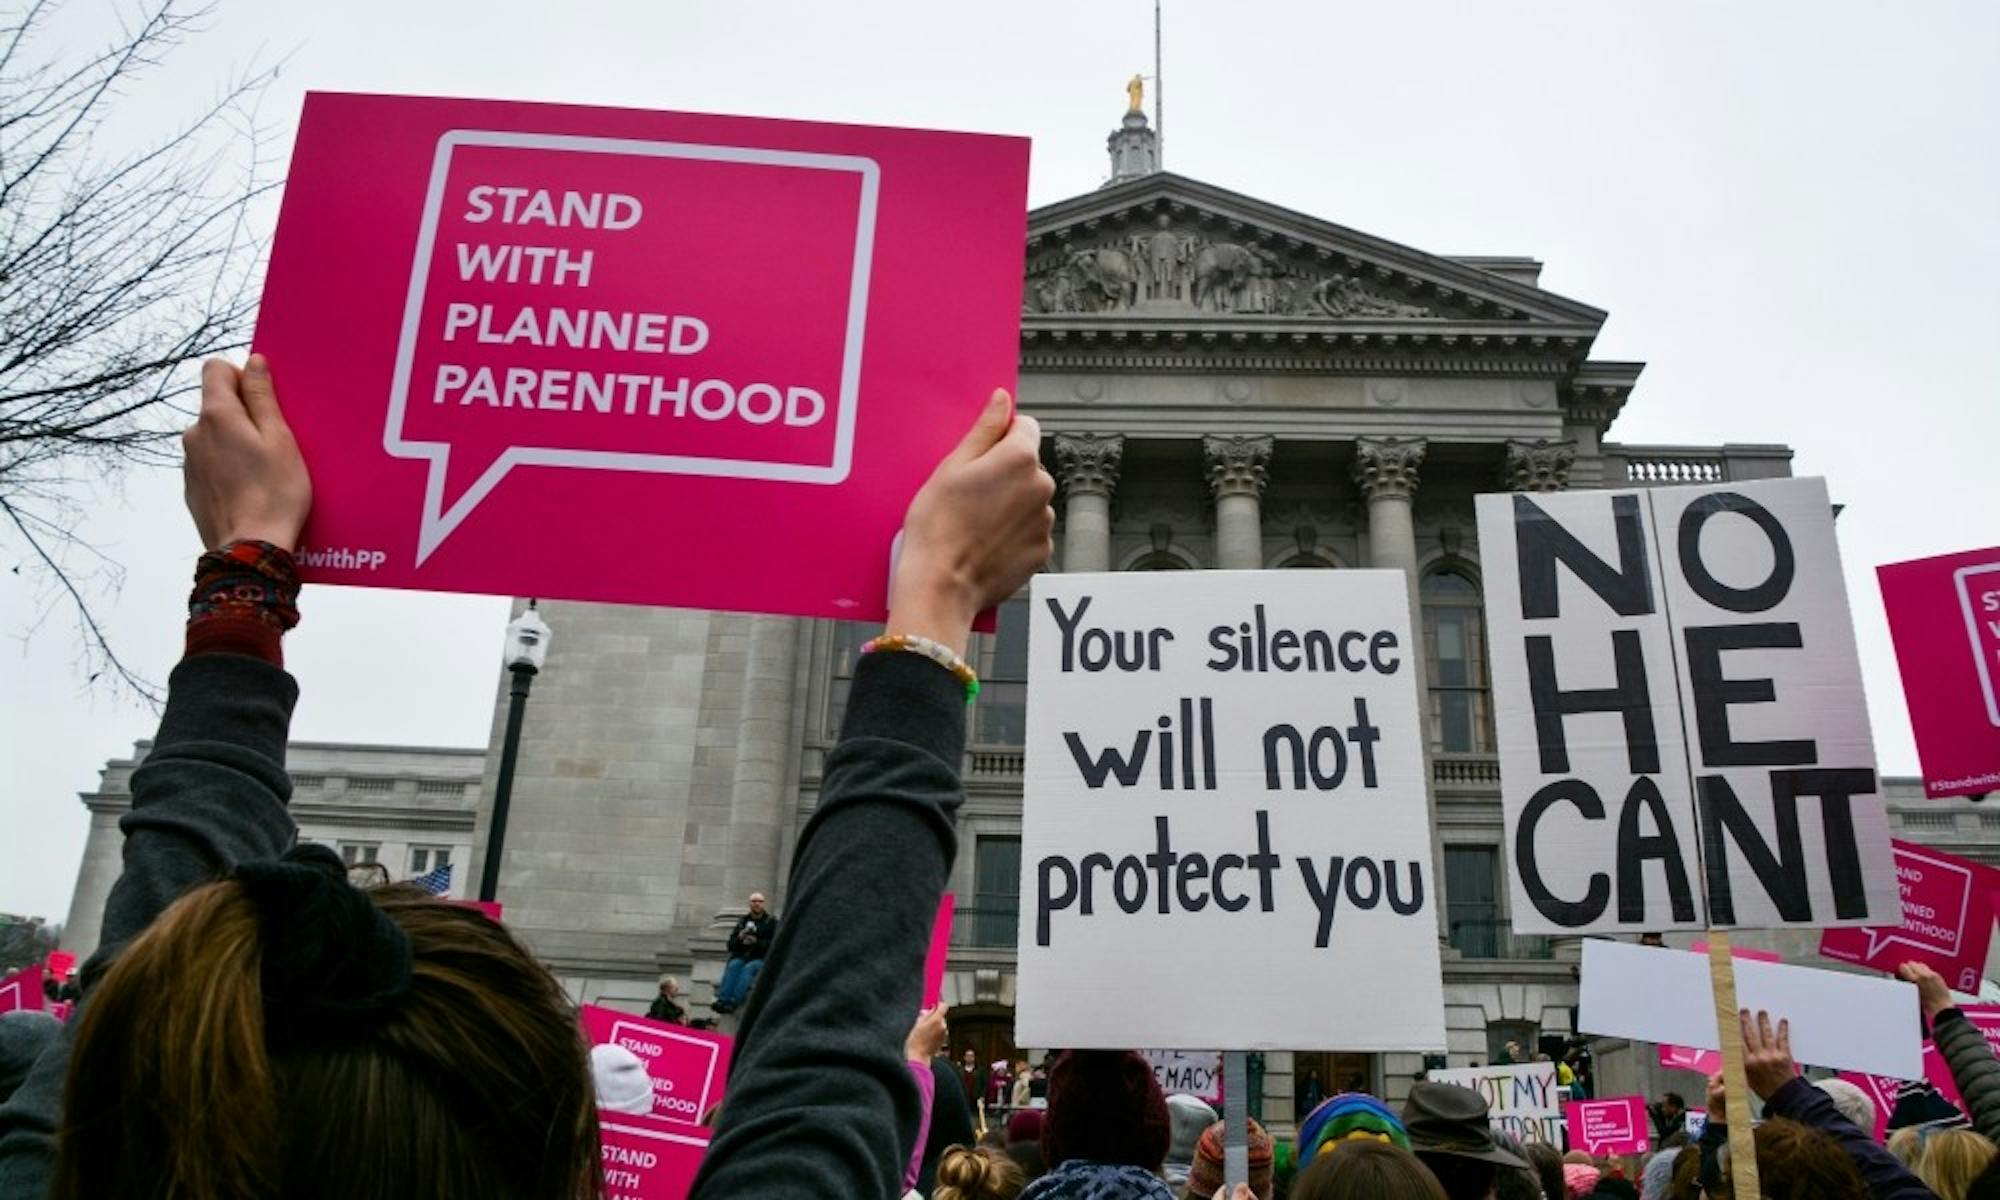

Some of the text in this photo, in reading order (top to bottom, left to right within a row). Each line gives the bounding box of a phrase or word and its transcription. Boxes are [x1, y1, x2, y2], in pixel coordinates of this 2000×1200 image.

[463, 185, 643, 231] STAND
[456, 242, 594, 288] WITH
[443, 302, 710, 356] PLANNED
[432, 364, 826, 428] PARENTHOOD
[1512, 491, 1796, 620] NO
[1045, 596, 1401, 675] Your silence
[1523, 621, 1818, 775] HE
[1062, 696, 1381, 791] will not
[1036, 810, 1425, 949] protect you
[1515, 767, 1877, 928] CANT
[1513, 1072, 1556, 1109] MY
